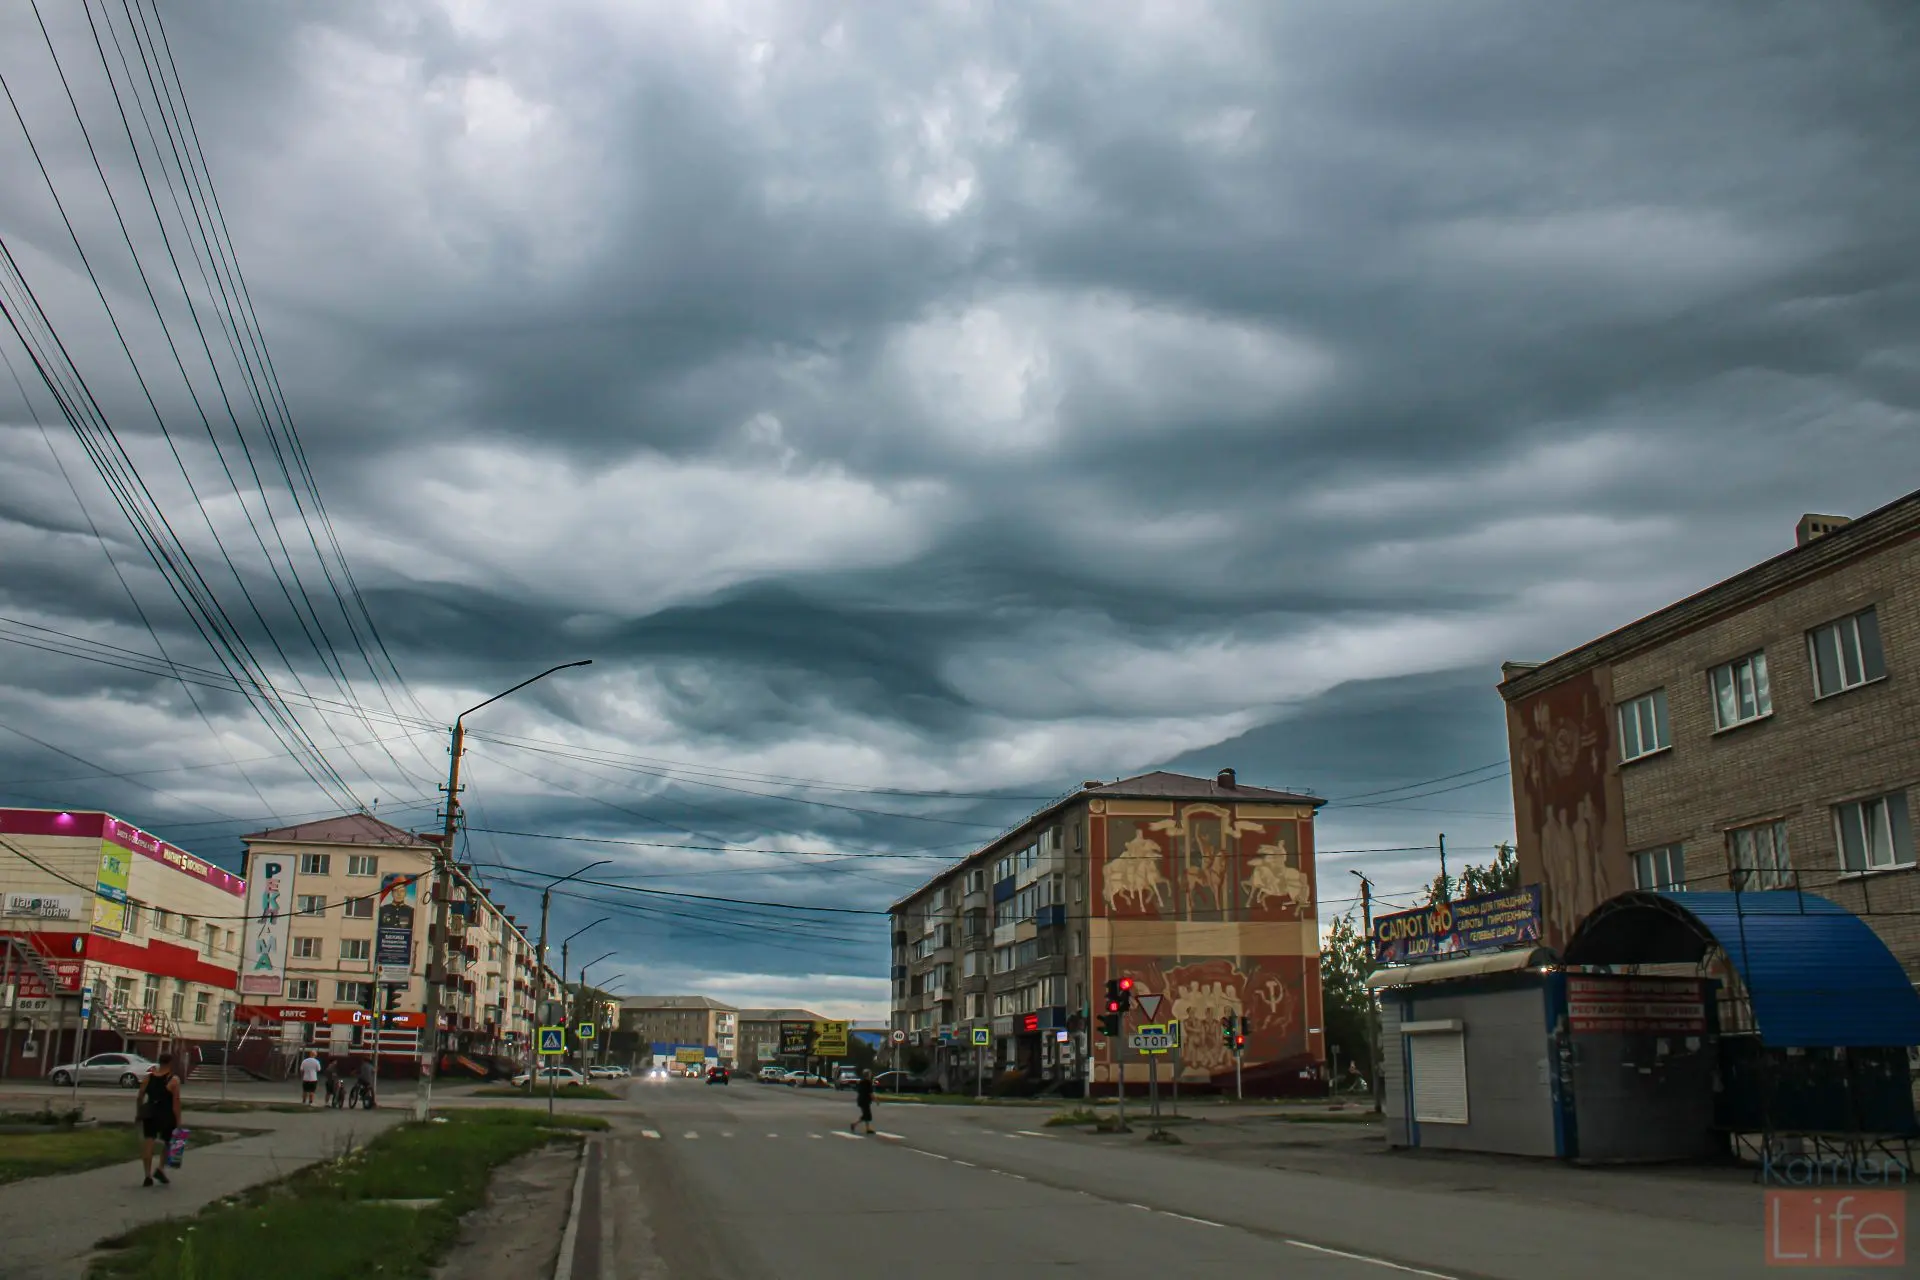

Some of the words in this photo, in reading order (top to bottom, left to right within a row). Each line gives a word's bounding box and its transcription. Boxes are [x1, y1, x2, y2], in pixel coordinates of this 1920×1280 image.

[254, 863, 281, 970] РЕКЛАМА
[1379, 914, 1424, 942] САЛЮТ
[1457, 918, 1483, 931] САЛЮТЫ
[1496, 924, 1517, 937] ШАРЫ
[1408, 939, 1430, 954] ШОУ
[286, 1010, 306, 1018] МТС
[1134, 1036, 1168, 1046] СТОП
